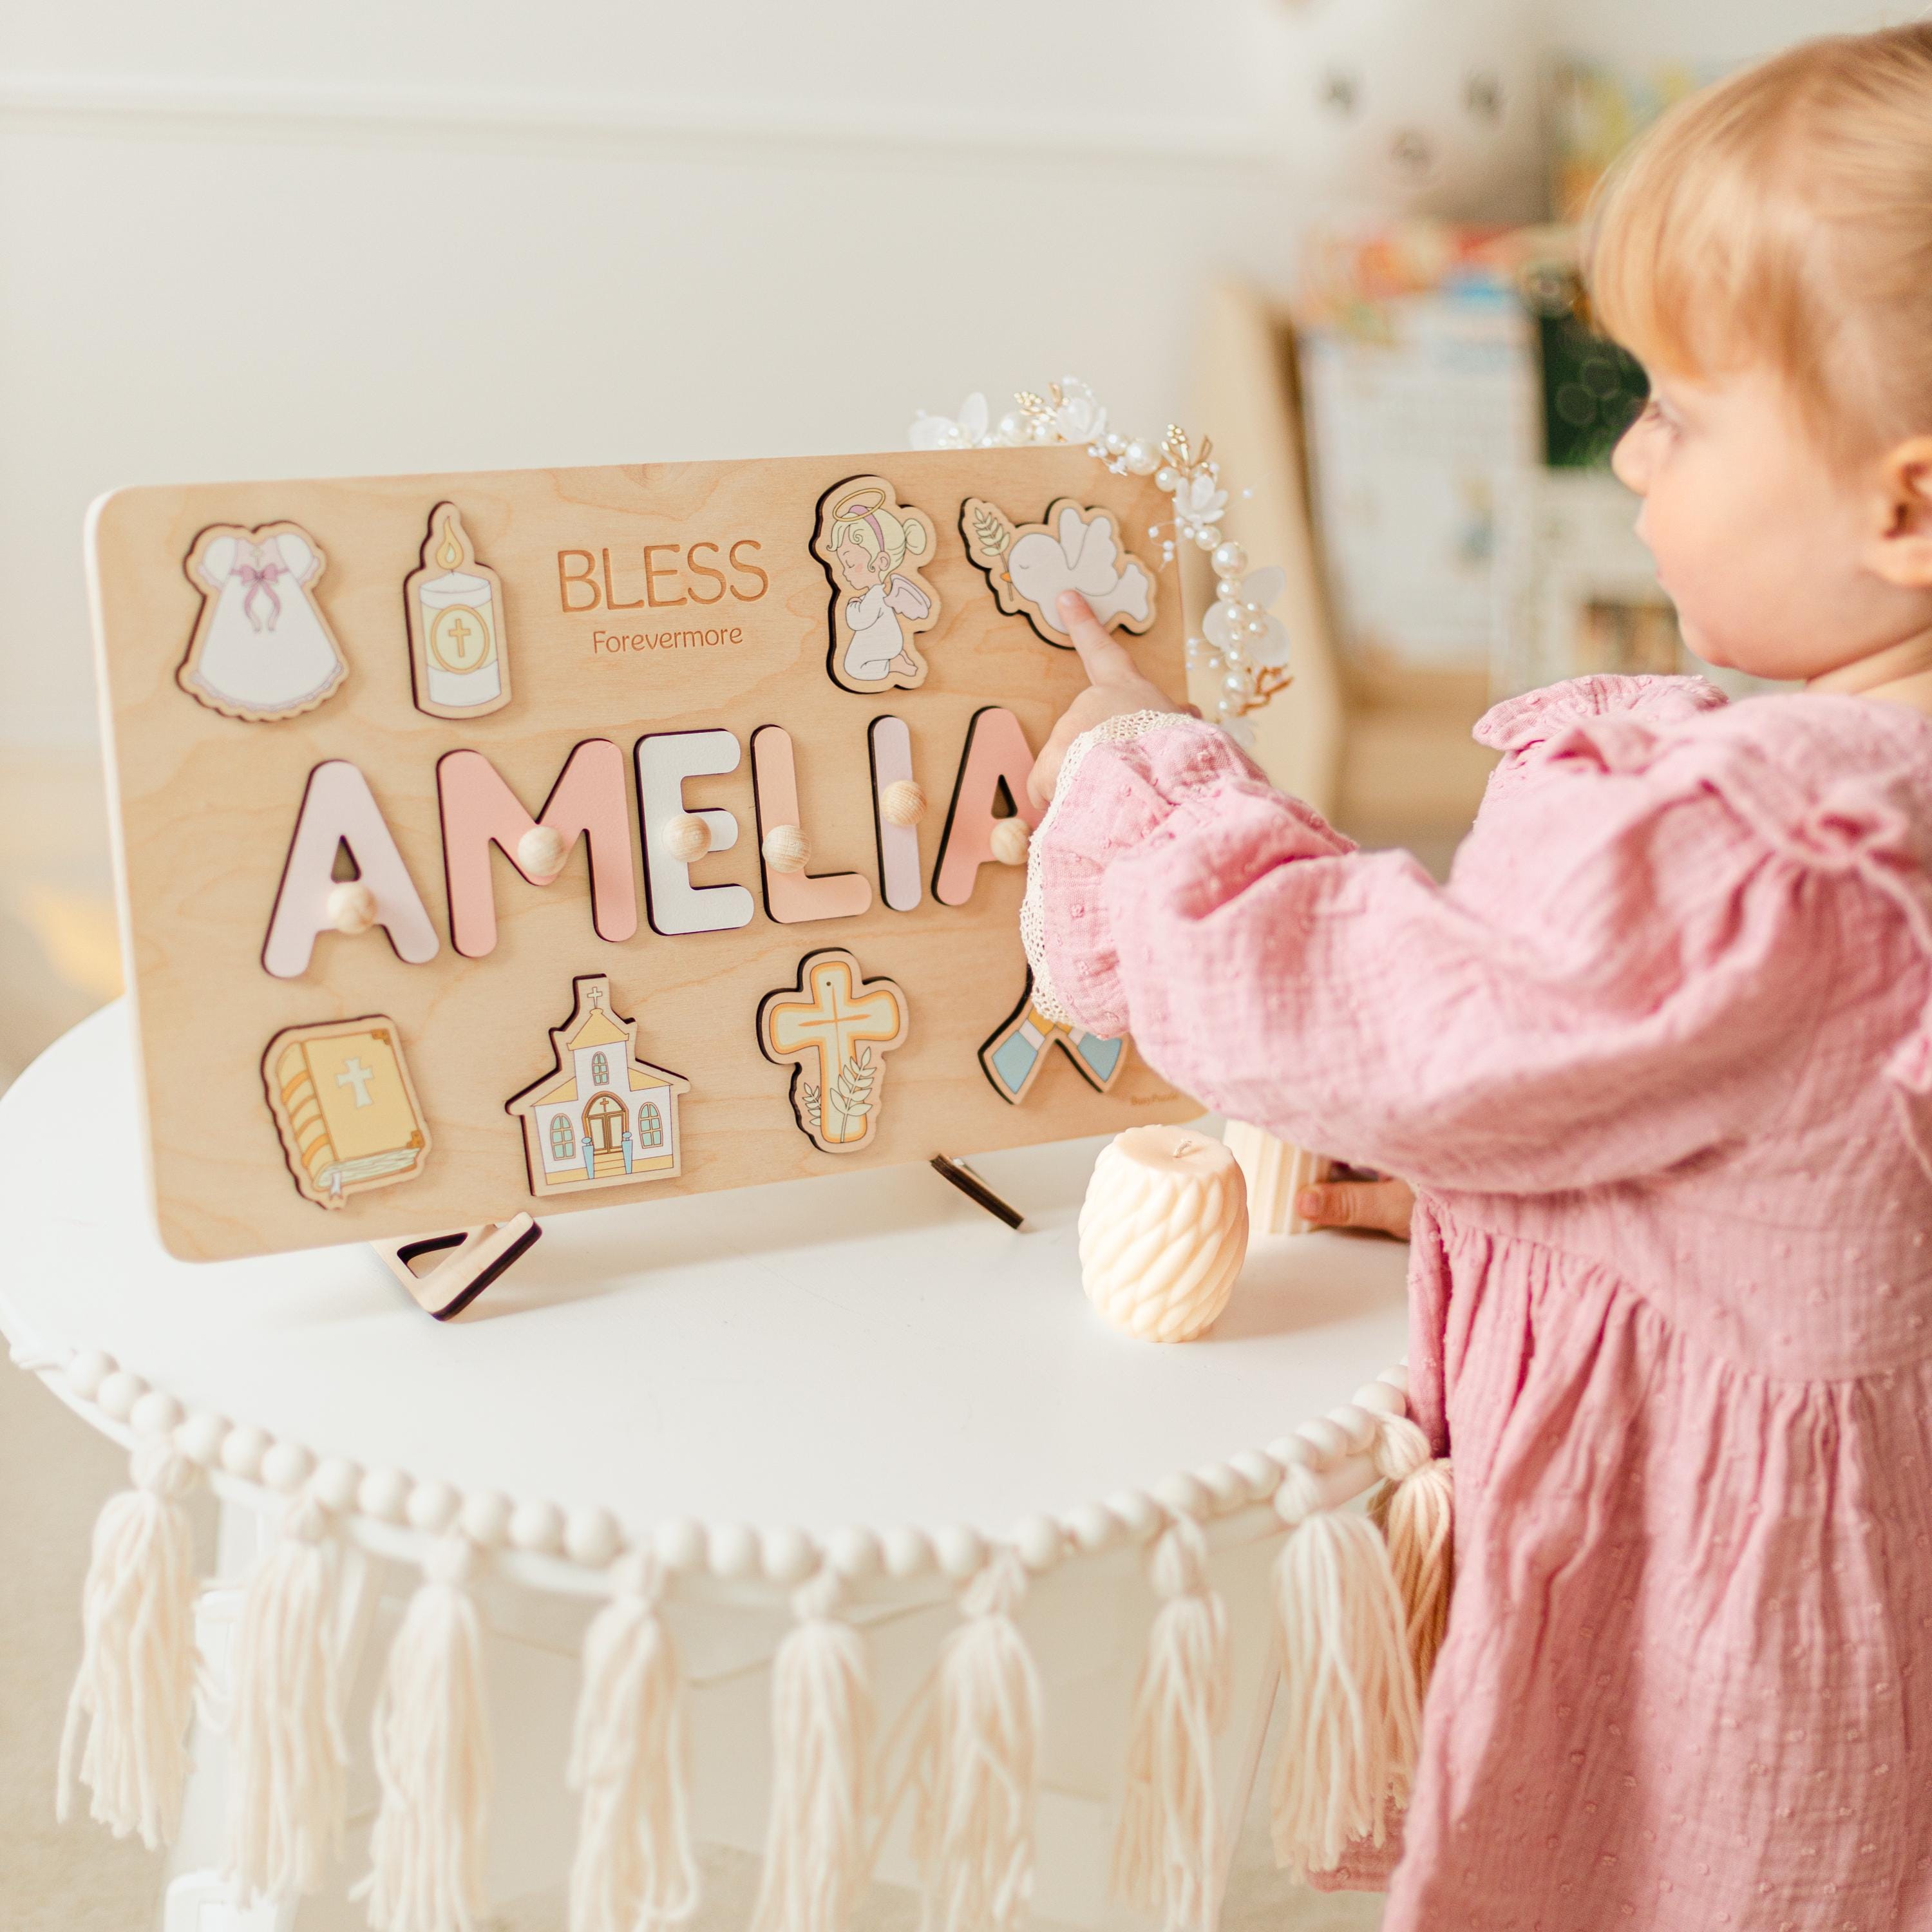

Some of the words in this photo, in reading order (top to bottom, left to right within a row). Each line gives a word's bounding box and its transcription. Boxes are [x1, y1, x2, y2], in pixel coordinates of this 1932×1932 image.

[558, 540, 769, 613] BLESS
[592, 627, 743, 654] Forevermore
[261, 706, 1046, 978] AMELIA
